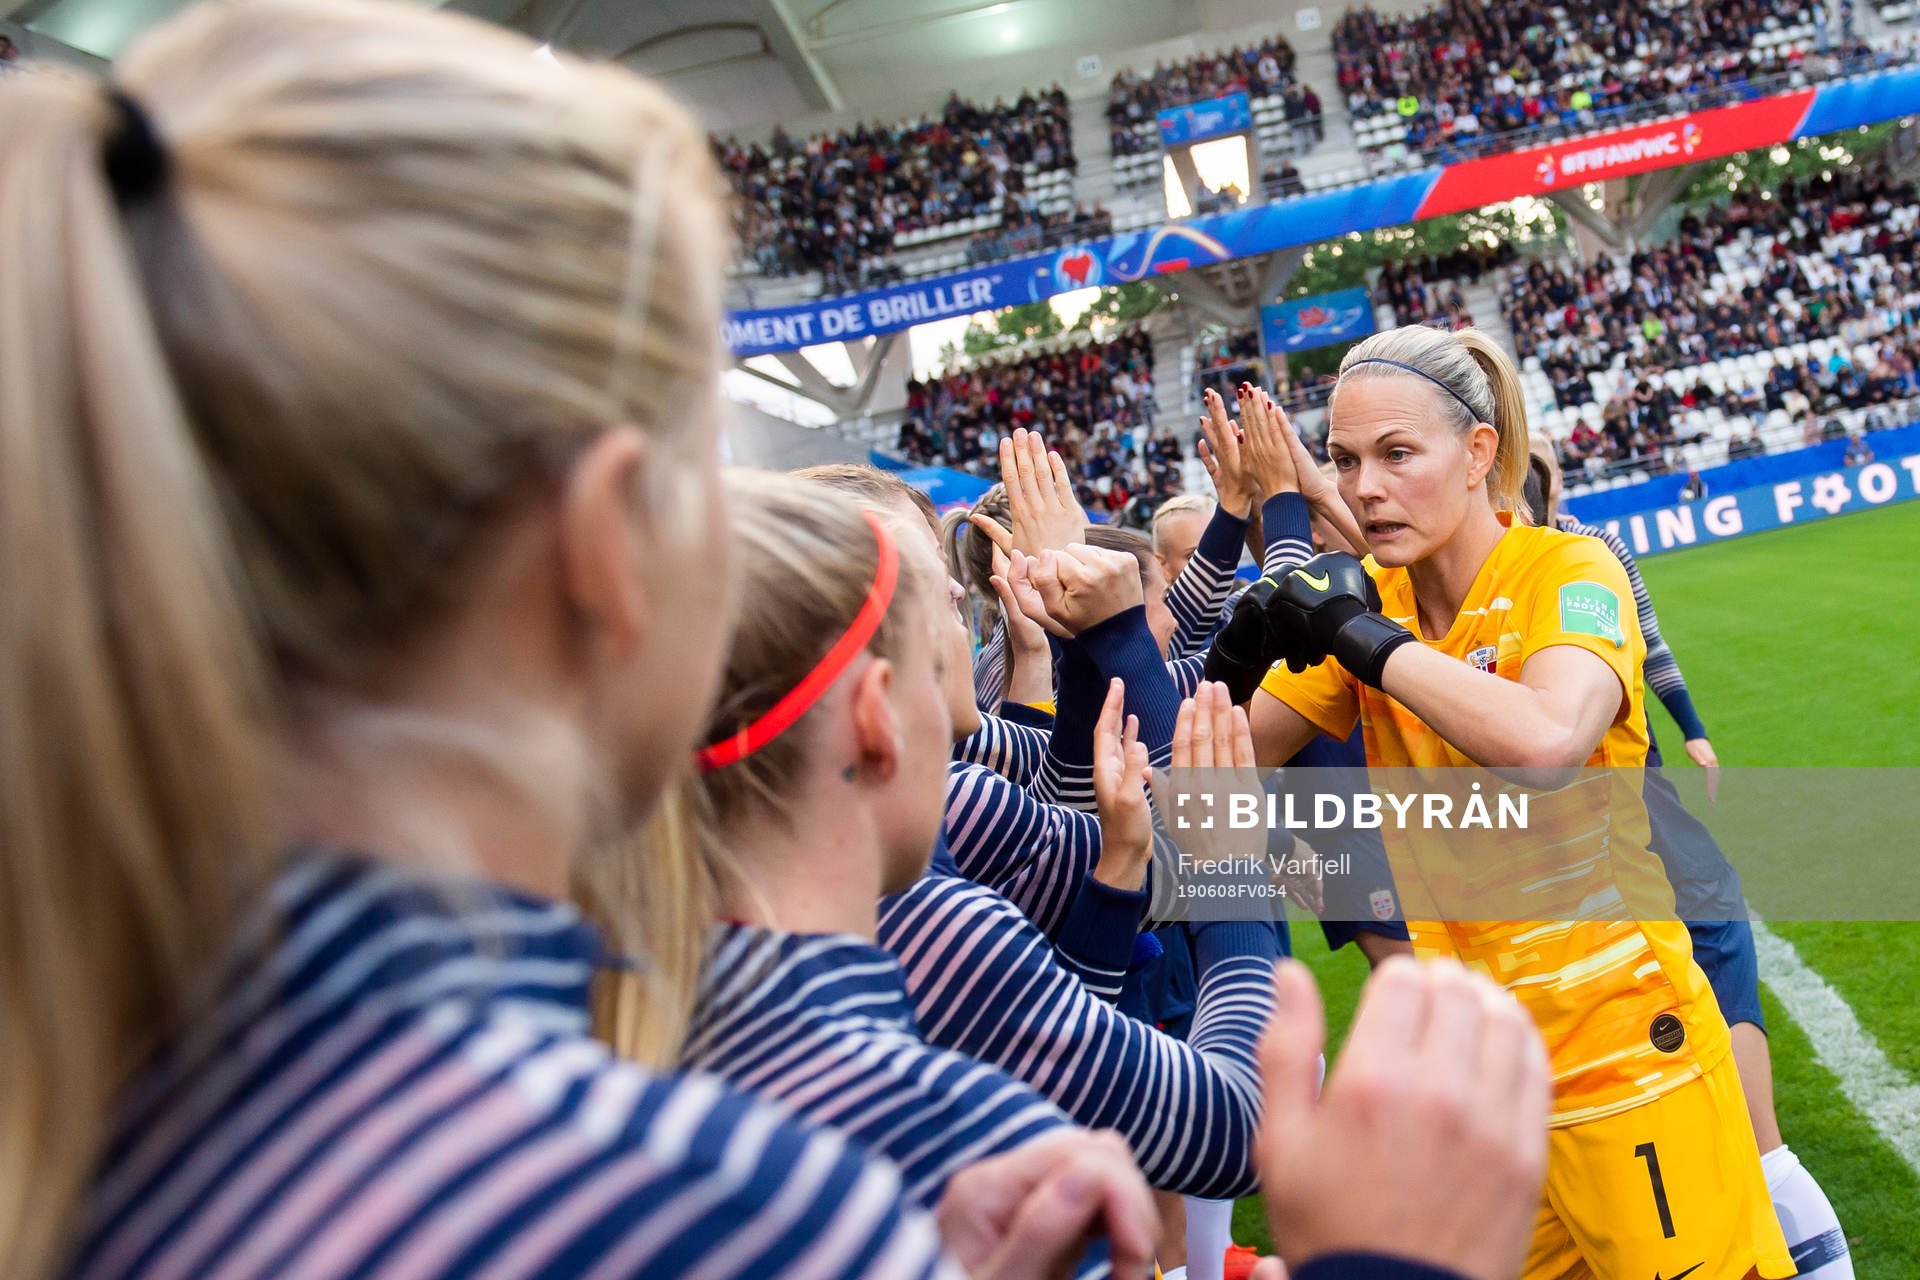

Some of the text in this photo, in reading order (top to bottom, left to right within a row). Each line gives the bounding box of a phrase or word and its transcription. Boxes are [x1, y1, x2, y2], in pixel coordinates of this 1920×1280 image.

[1561, 131, 1679, 175] #FIFAWWC
[820, 304, 866, 337] DE
[1566, 594, 1616, 617] LIVING
[1566, 600, 1615, 624] FOOTBALL
[1634, 1141, 1676, 1239] 1
